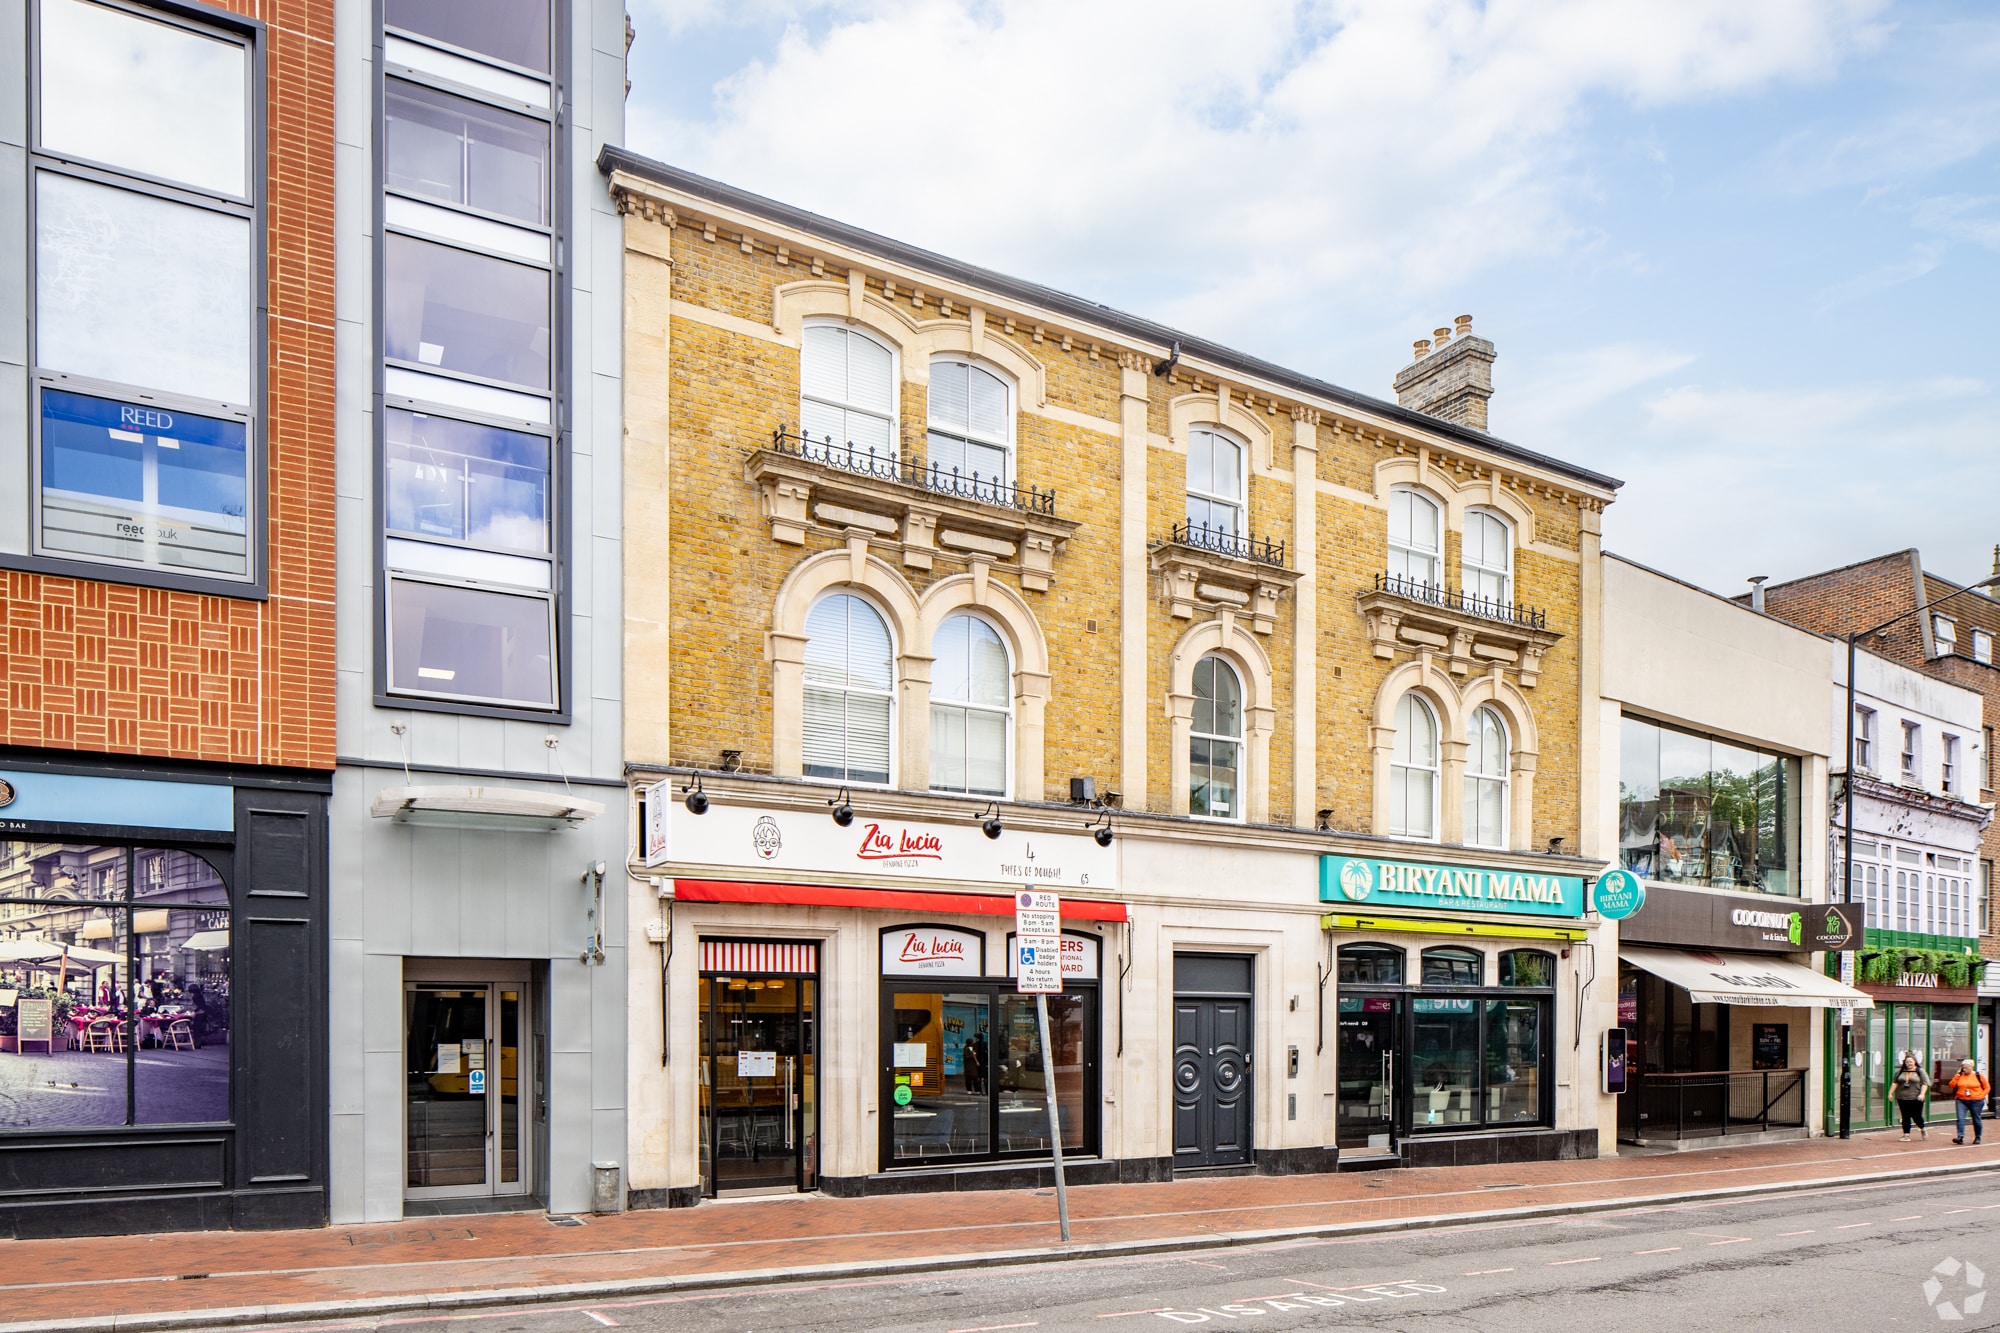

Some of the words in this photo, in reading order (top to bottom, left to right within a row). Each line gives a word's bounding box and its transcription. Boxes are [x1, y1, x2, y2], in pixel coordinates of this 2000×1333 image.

[121, 406, 173, 430] REED
[860, 823, 894, 854] Zia
[899, 828, 942, 852] Lucia
[1026, 841, 1036, 862] 4
[1024, 866, 1032, 877] OF
[1034, 867, 1061, 880] DOUGH!
[1377, 863, 1483, 898] BIRYANI
[1487, 872, 1565, 904] MAMA
[1438, 898, 1454, 907] BAR
[1461, 900, 1508, 910] RESTAURANT
[1600, 892, 1632, 902] BIRYANI
[1603, 900, 1629, 909] MAMA
[1732, 909, 1790, 930] COCONUT
[901, 932, 928, 958] Zia
[931, 936, 964, 956] Lucia
[1155, 1283, 1448, 1324] DISABLED
